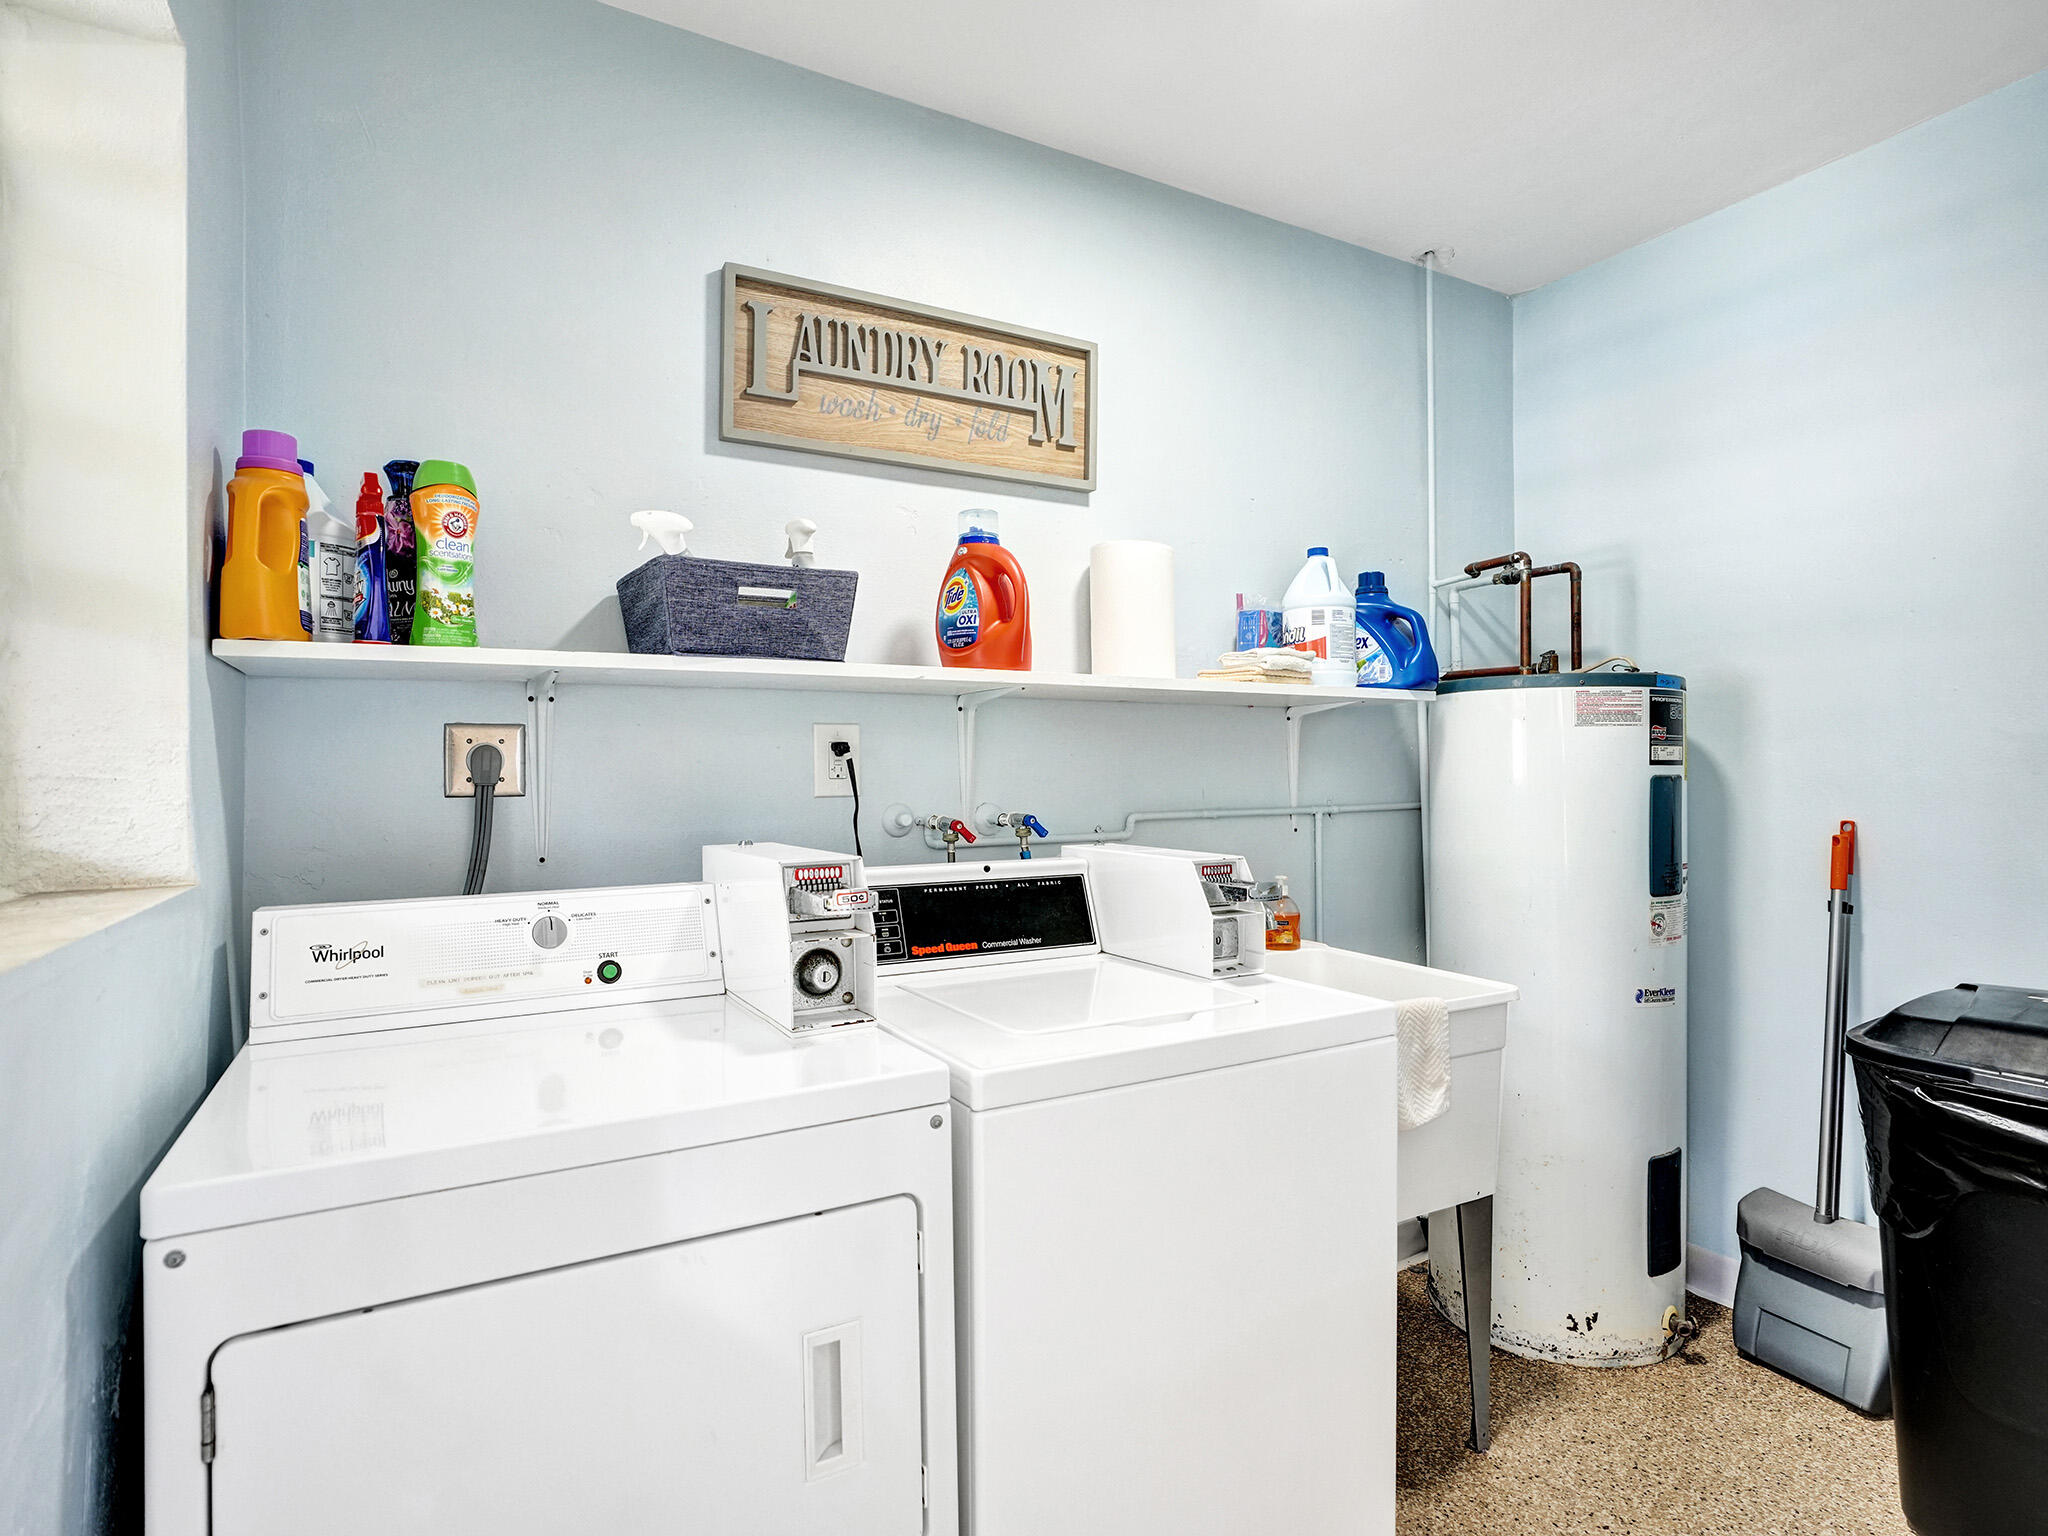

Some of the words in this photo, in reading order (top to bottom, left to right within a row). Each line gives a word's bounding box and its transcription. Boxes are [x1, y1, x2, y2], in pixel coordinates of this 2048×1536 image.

[745, 300, 948, 402] LAUNDRY
[961, 345, 1079, 448] ROOM
[819, 389, 882, 422] wash
[904, 396, 943, 442] dry
[967, 406, 1011, 445] fold
[436, 537, 470, 553] clean
[944, 586, 965, 609] Tide
[958, 615, 977, 626] OXI
[924, 885, 967, 893] PERMANENT
[311, 945, 384, 964] Whirlpool
[598, 951, 619, 959] START
[911, 943, 945, 956] Speed
[945, 941, 978, 953] Queen
[982, 938, 1018, 949] Commercial
[1019, 937, 1042, 945] Washer
